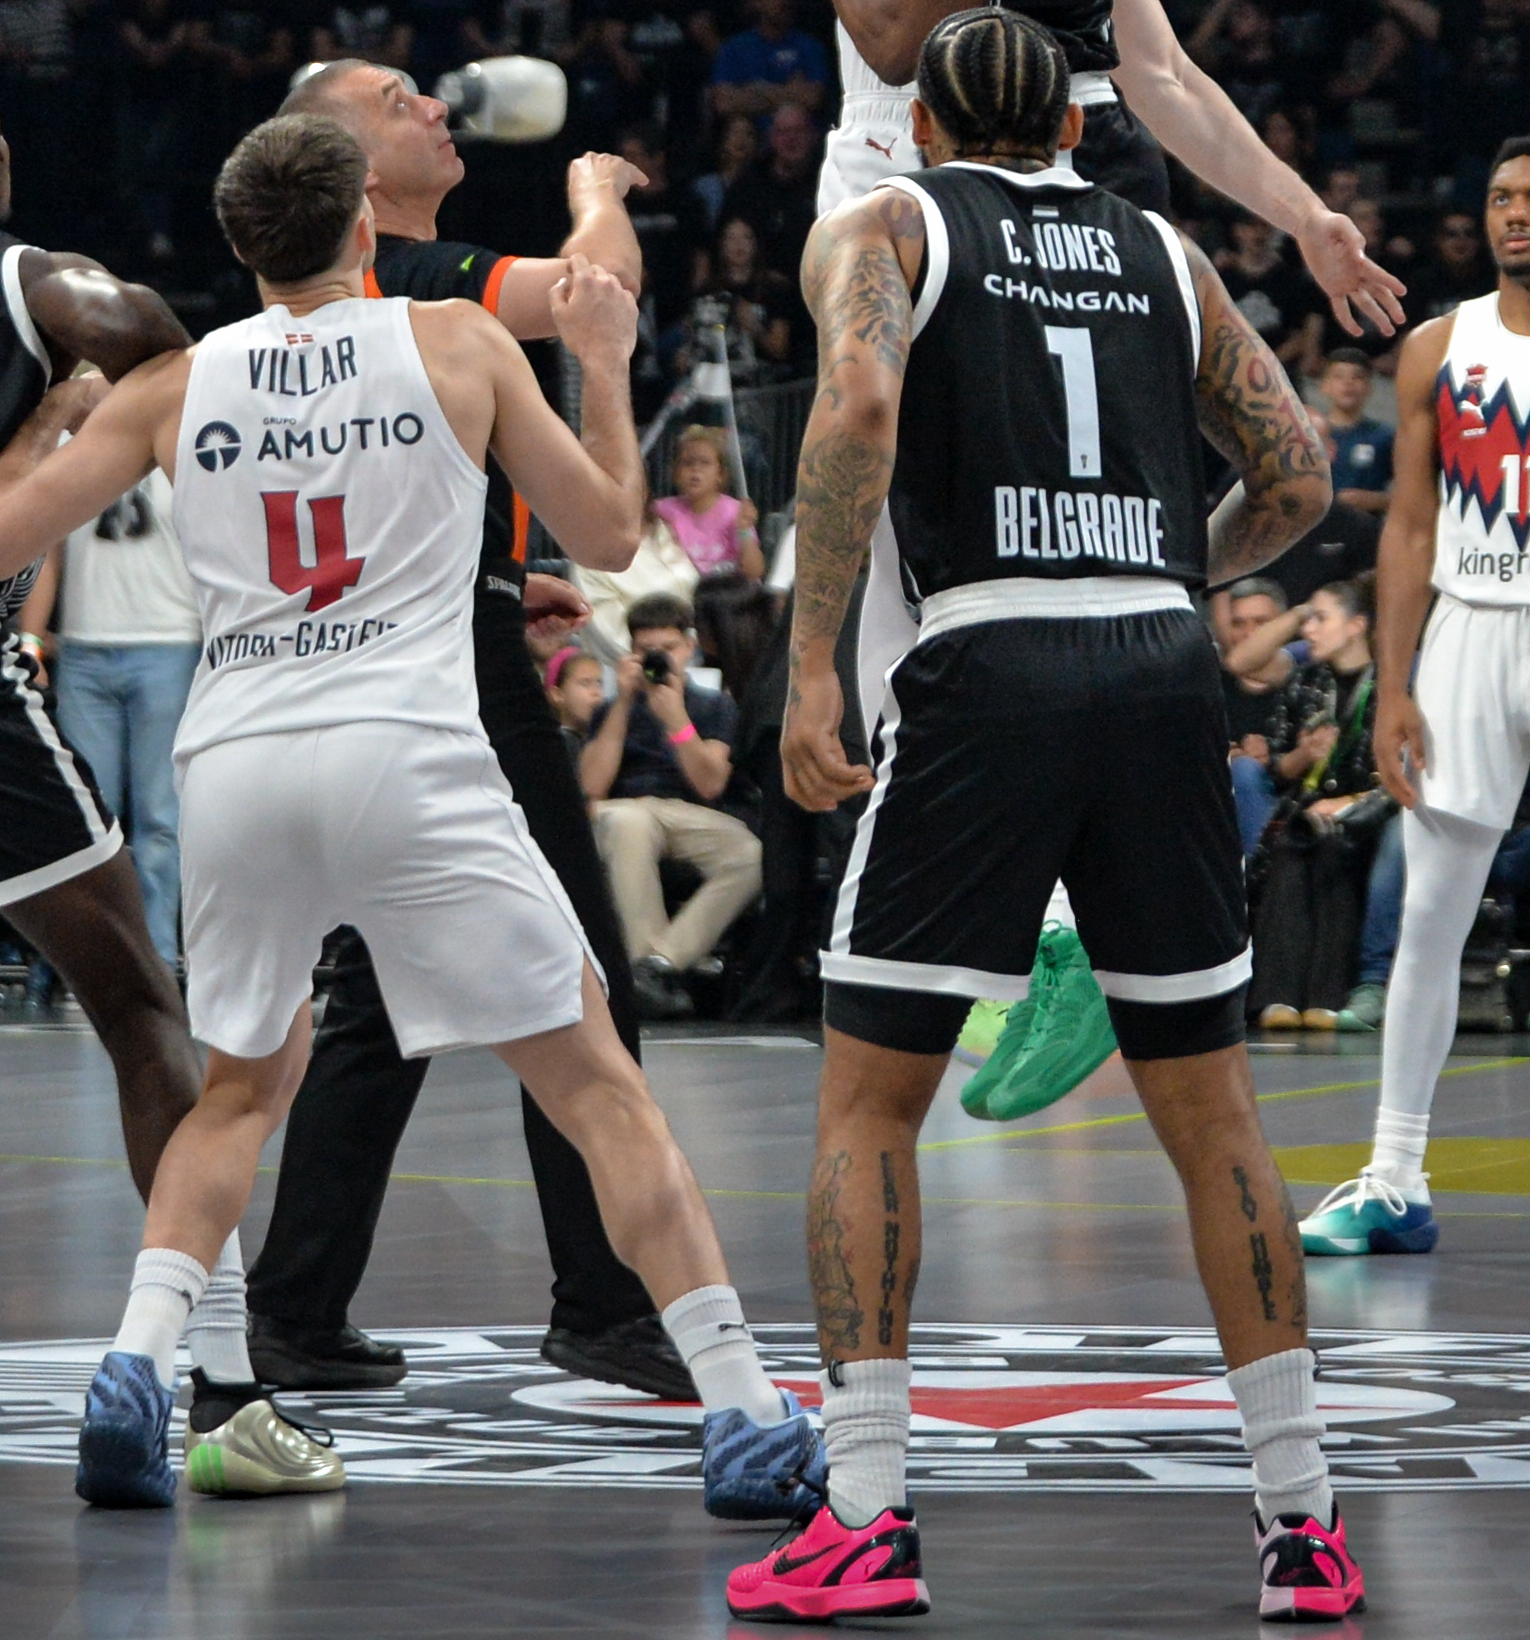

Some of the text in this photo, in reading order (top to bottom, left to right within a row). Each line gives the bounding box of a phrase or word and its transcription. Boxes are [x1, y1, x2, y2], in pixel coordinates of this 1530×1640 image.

[999, 218, 1123, 276] C. JONES
[983, 273, 1151, 315] CHANGAN
[248, 335, 359, 397] VILLAR
[1044, 324, 1103, 479] 1
[257, 411, 425, 461] AMUTIO
[259, 490, 367, 613] 4
[994, 485, 1166, 569] BELGRADE
